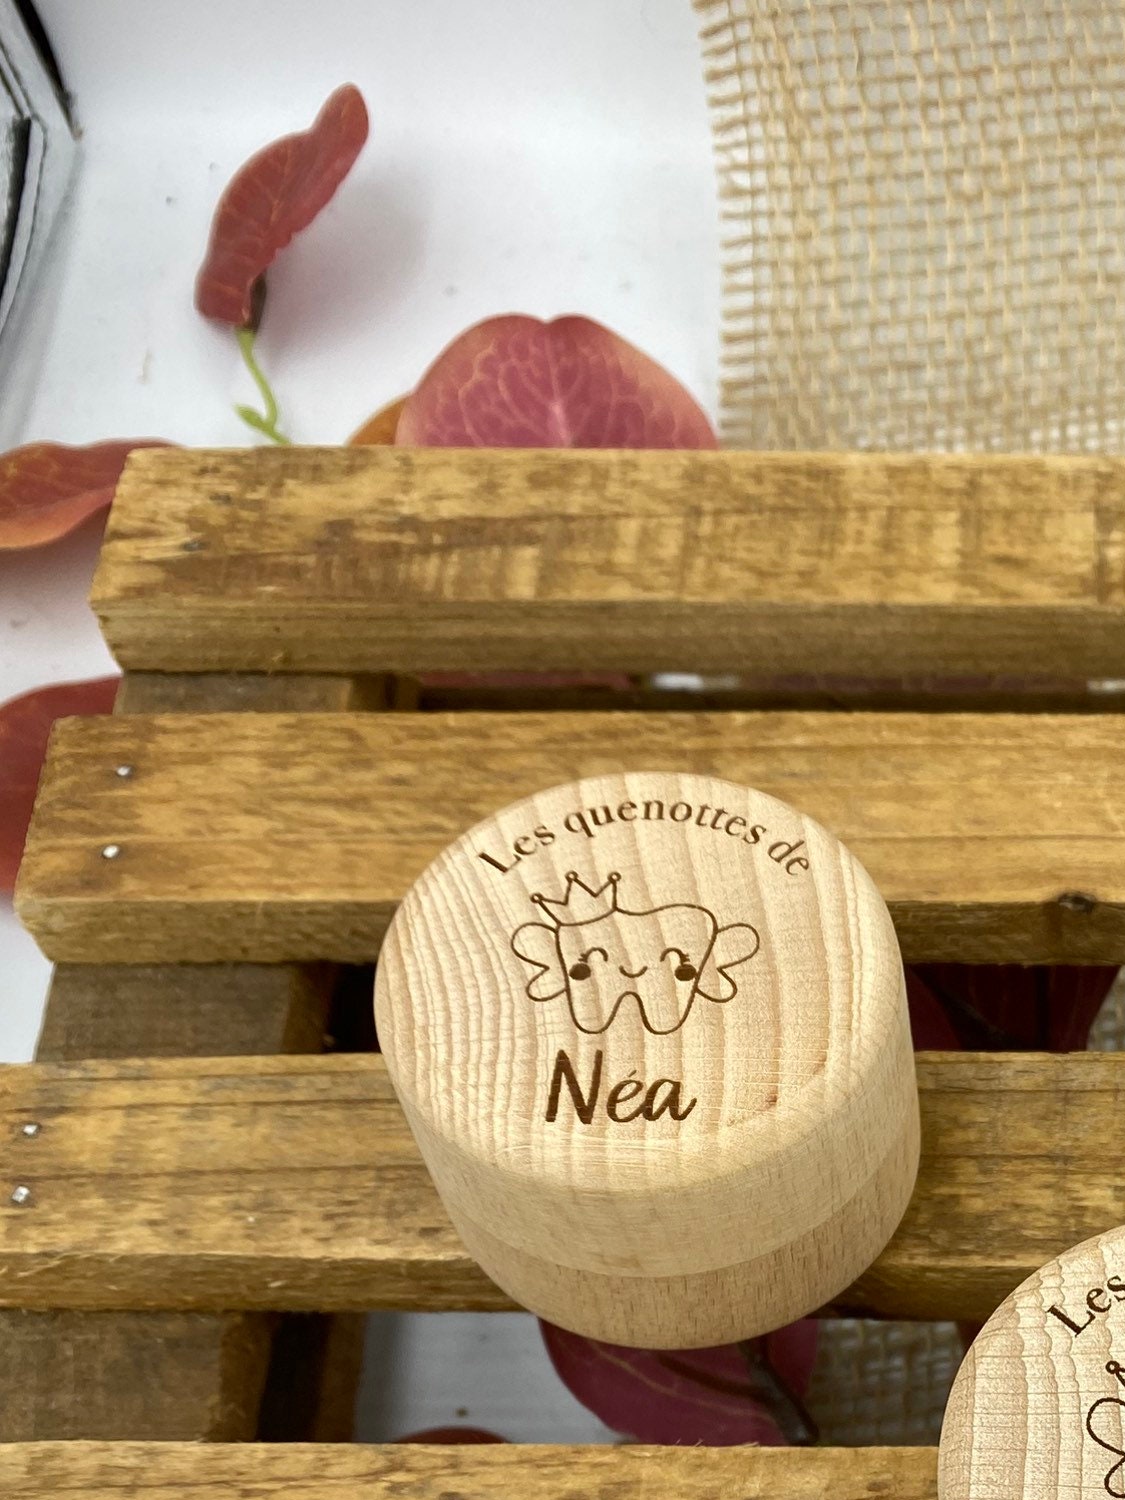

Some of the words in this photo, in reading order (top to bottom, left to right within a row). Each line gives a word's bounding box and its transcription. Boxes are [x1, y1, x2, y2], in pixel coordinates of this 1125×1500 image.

[479, 823, 555, 875] Les
[564, 799, 767, 845] quenottes
[768, 839, 809, 878] de
[545, 1050, 697, 1124] Néa
